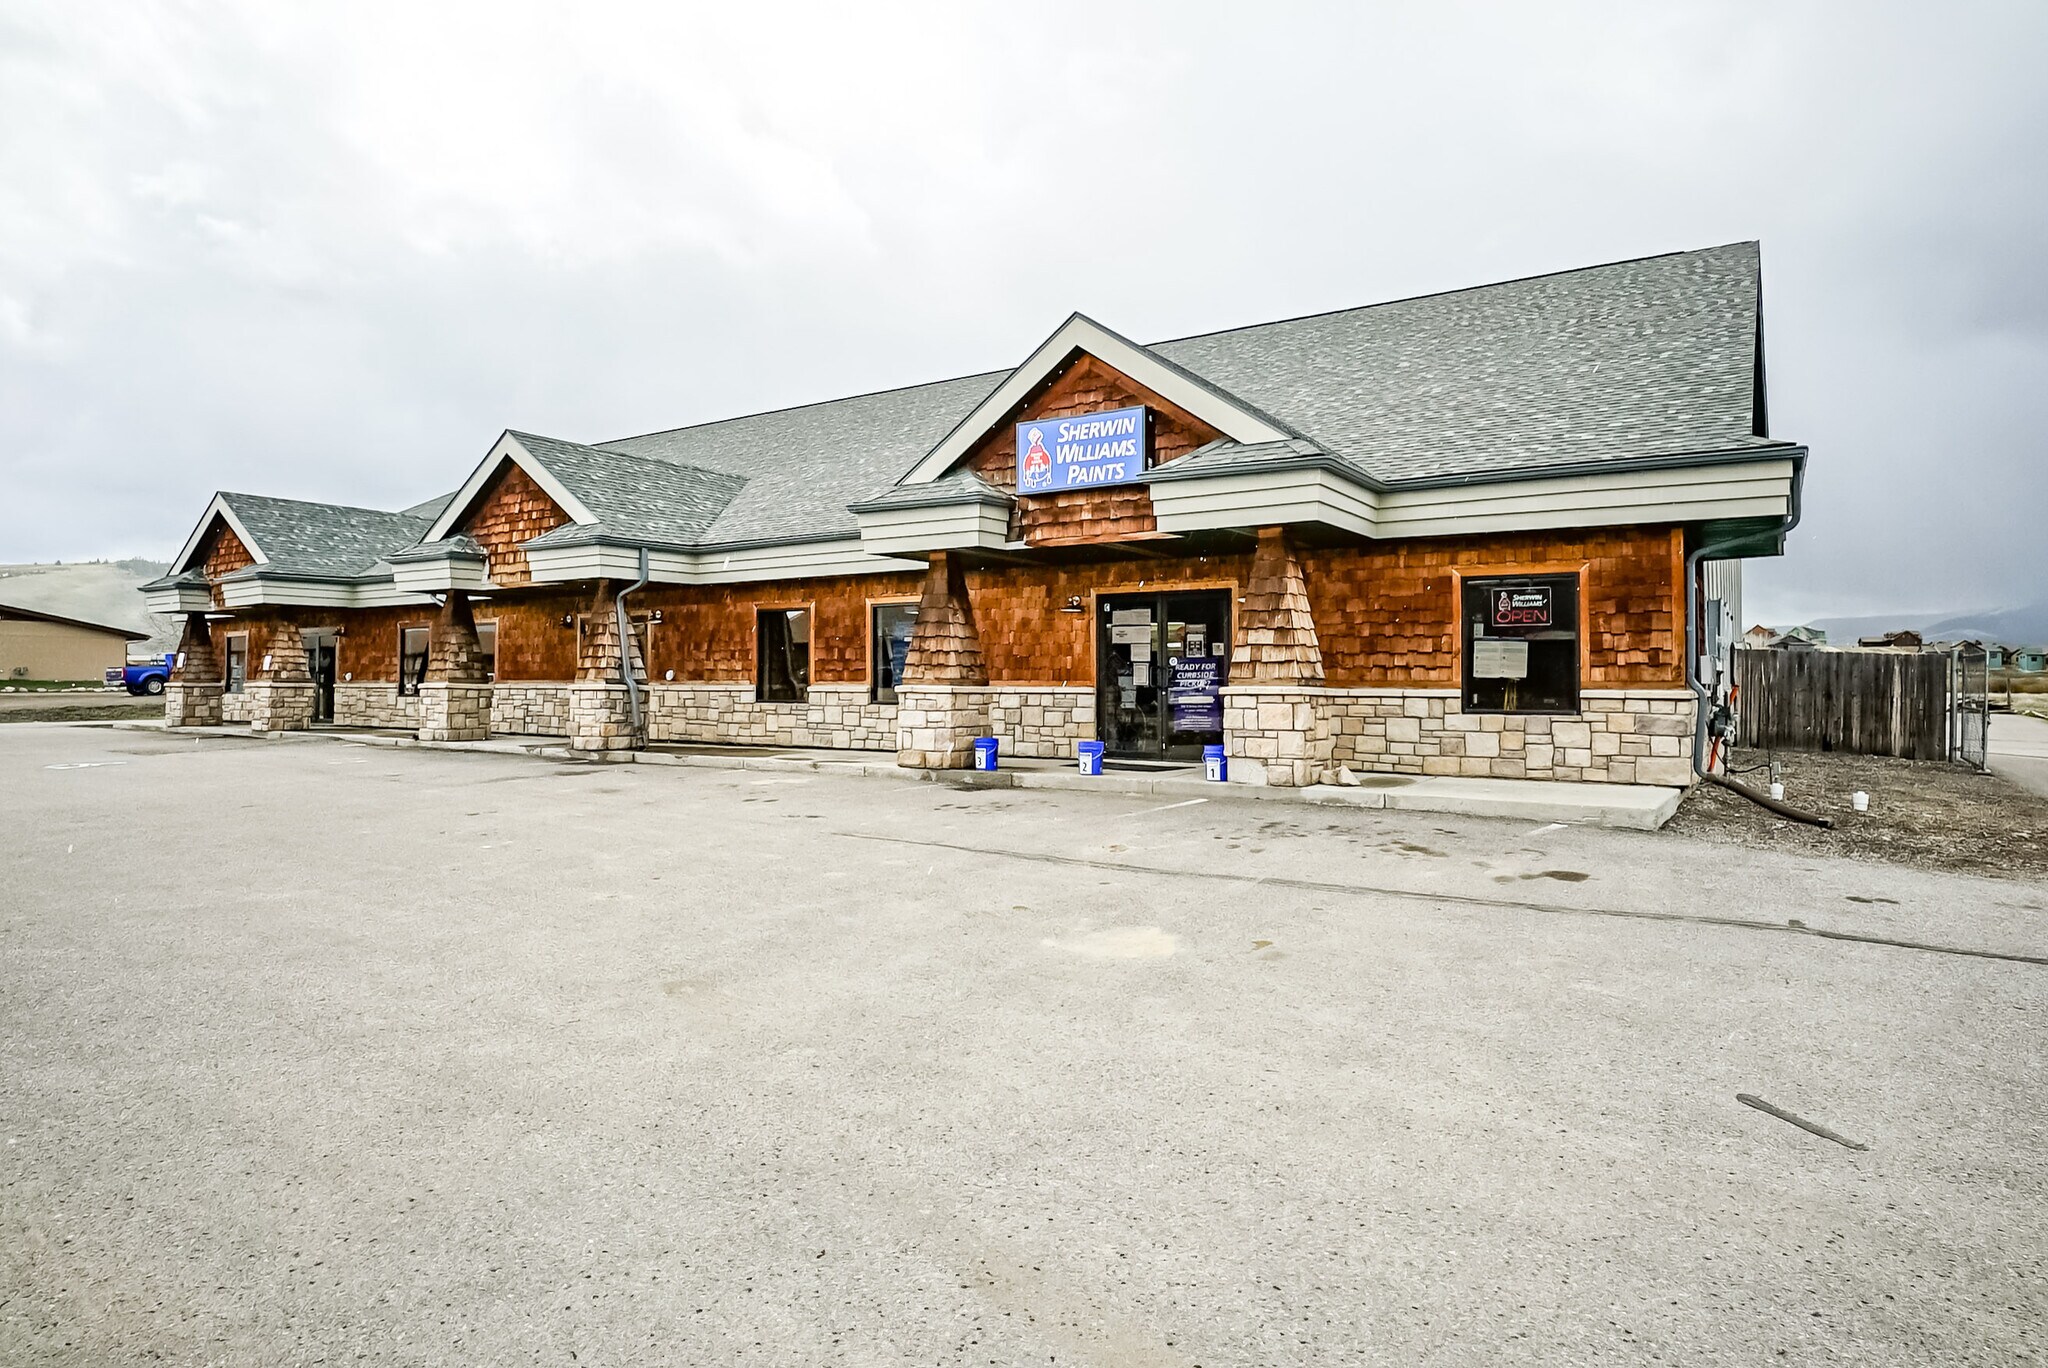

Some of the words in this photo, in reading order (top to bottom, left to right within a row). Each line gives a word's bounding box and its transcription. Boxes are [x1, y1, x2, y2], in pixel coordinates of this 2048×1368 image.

[1057, 417, 1136, 443] SHERWIN
[1056, 438, 1136, 464] WILLIAMS
[1066, 463, 1125, 485] PAINTS
[1496, 609, 1547, 623] OPEN
[1175, 663, 1201, 671] READY
[1201, 662, 1216, 670] FOR
[1177, 671, 1214, 679] CURBSIDE
[977, 756, 982, 766] 3
[1082, 762, 1087, 772] 2
[1211, 768, 1215, 778] 1
